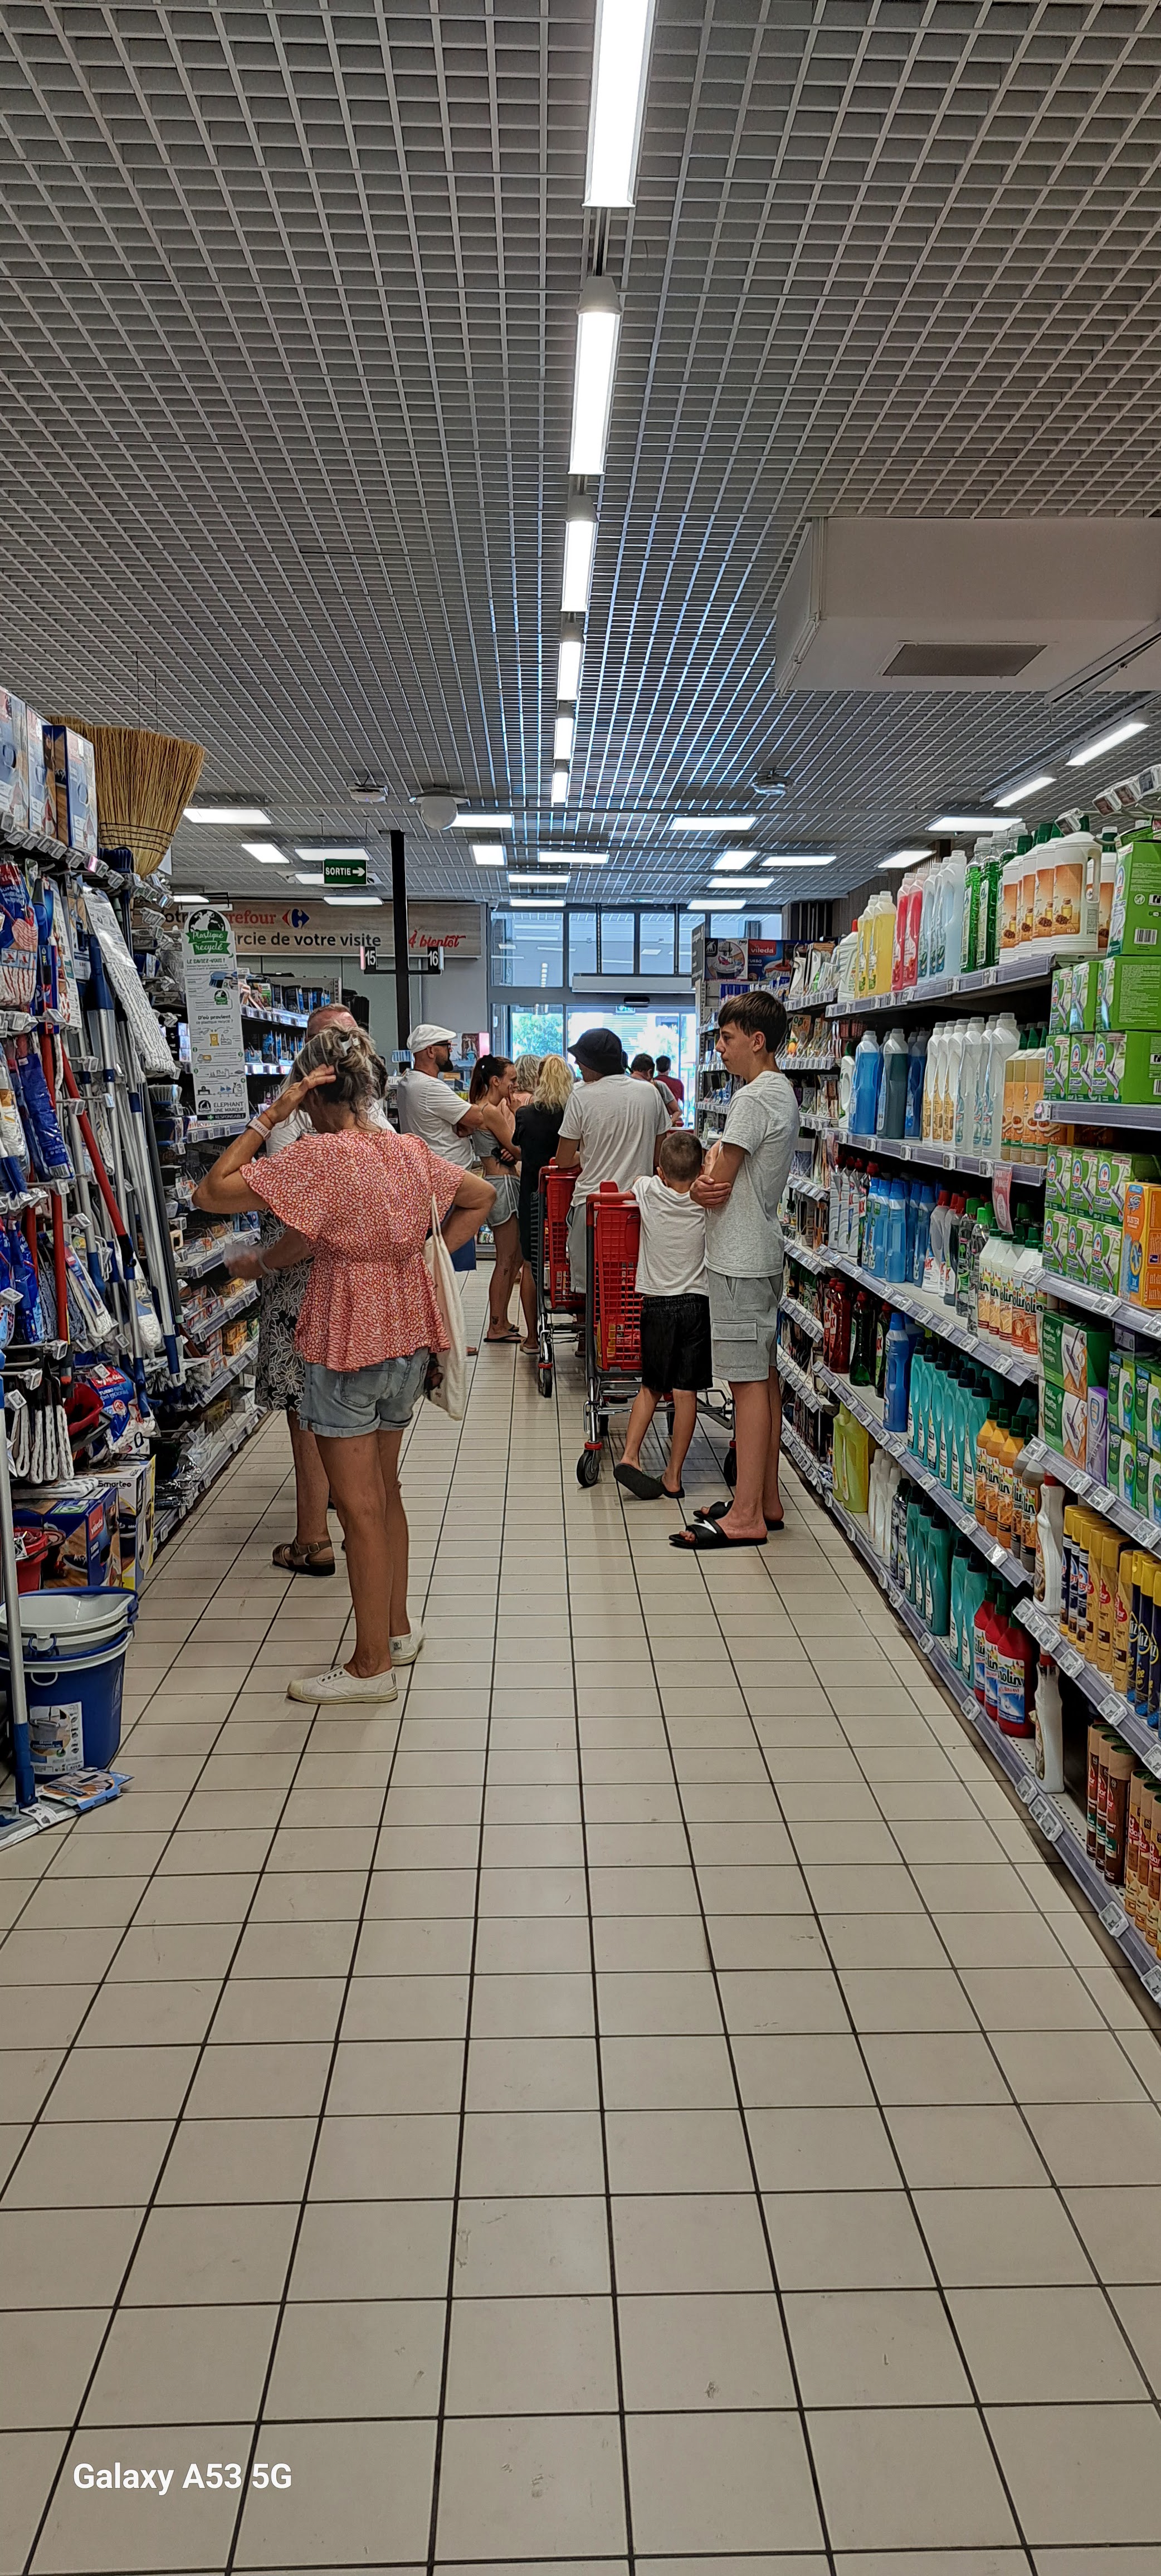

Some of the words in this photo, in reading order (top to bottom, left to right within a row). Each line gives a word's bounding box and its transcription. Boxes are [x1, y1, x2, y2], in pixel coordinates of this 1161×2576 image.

[325, 867, 351, 876] SORTIE
[228, 910, 276, 924] refour
[193, 931, 224, 941] Plastique
[236, 931, 266, 945] rcie
[271, 932, 290, 945] de
[294, 935, 335, 946] votre
[340, 933, 381, 947] visite
[408, 930, 417, 948] À
[420, 934, 466, 948] bientôt
[196, 942, 223, 954] recyclé
[750, 945, 774, 954] vileda
[365, 952, 375, 966] 15
[428, 952, 438, 967] 16
[1139, 1629, 1148, 1647] liz
